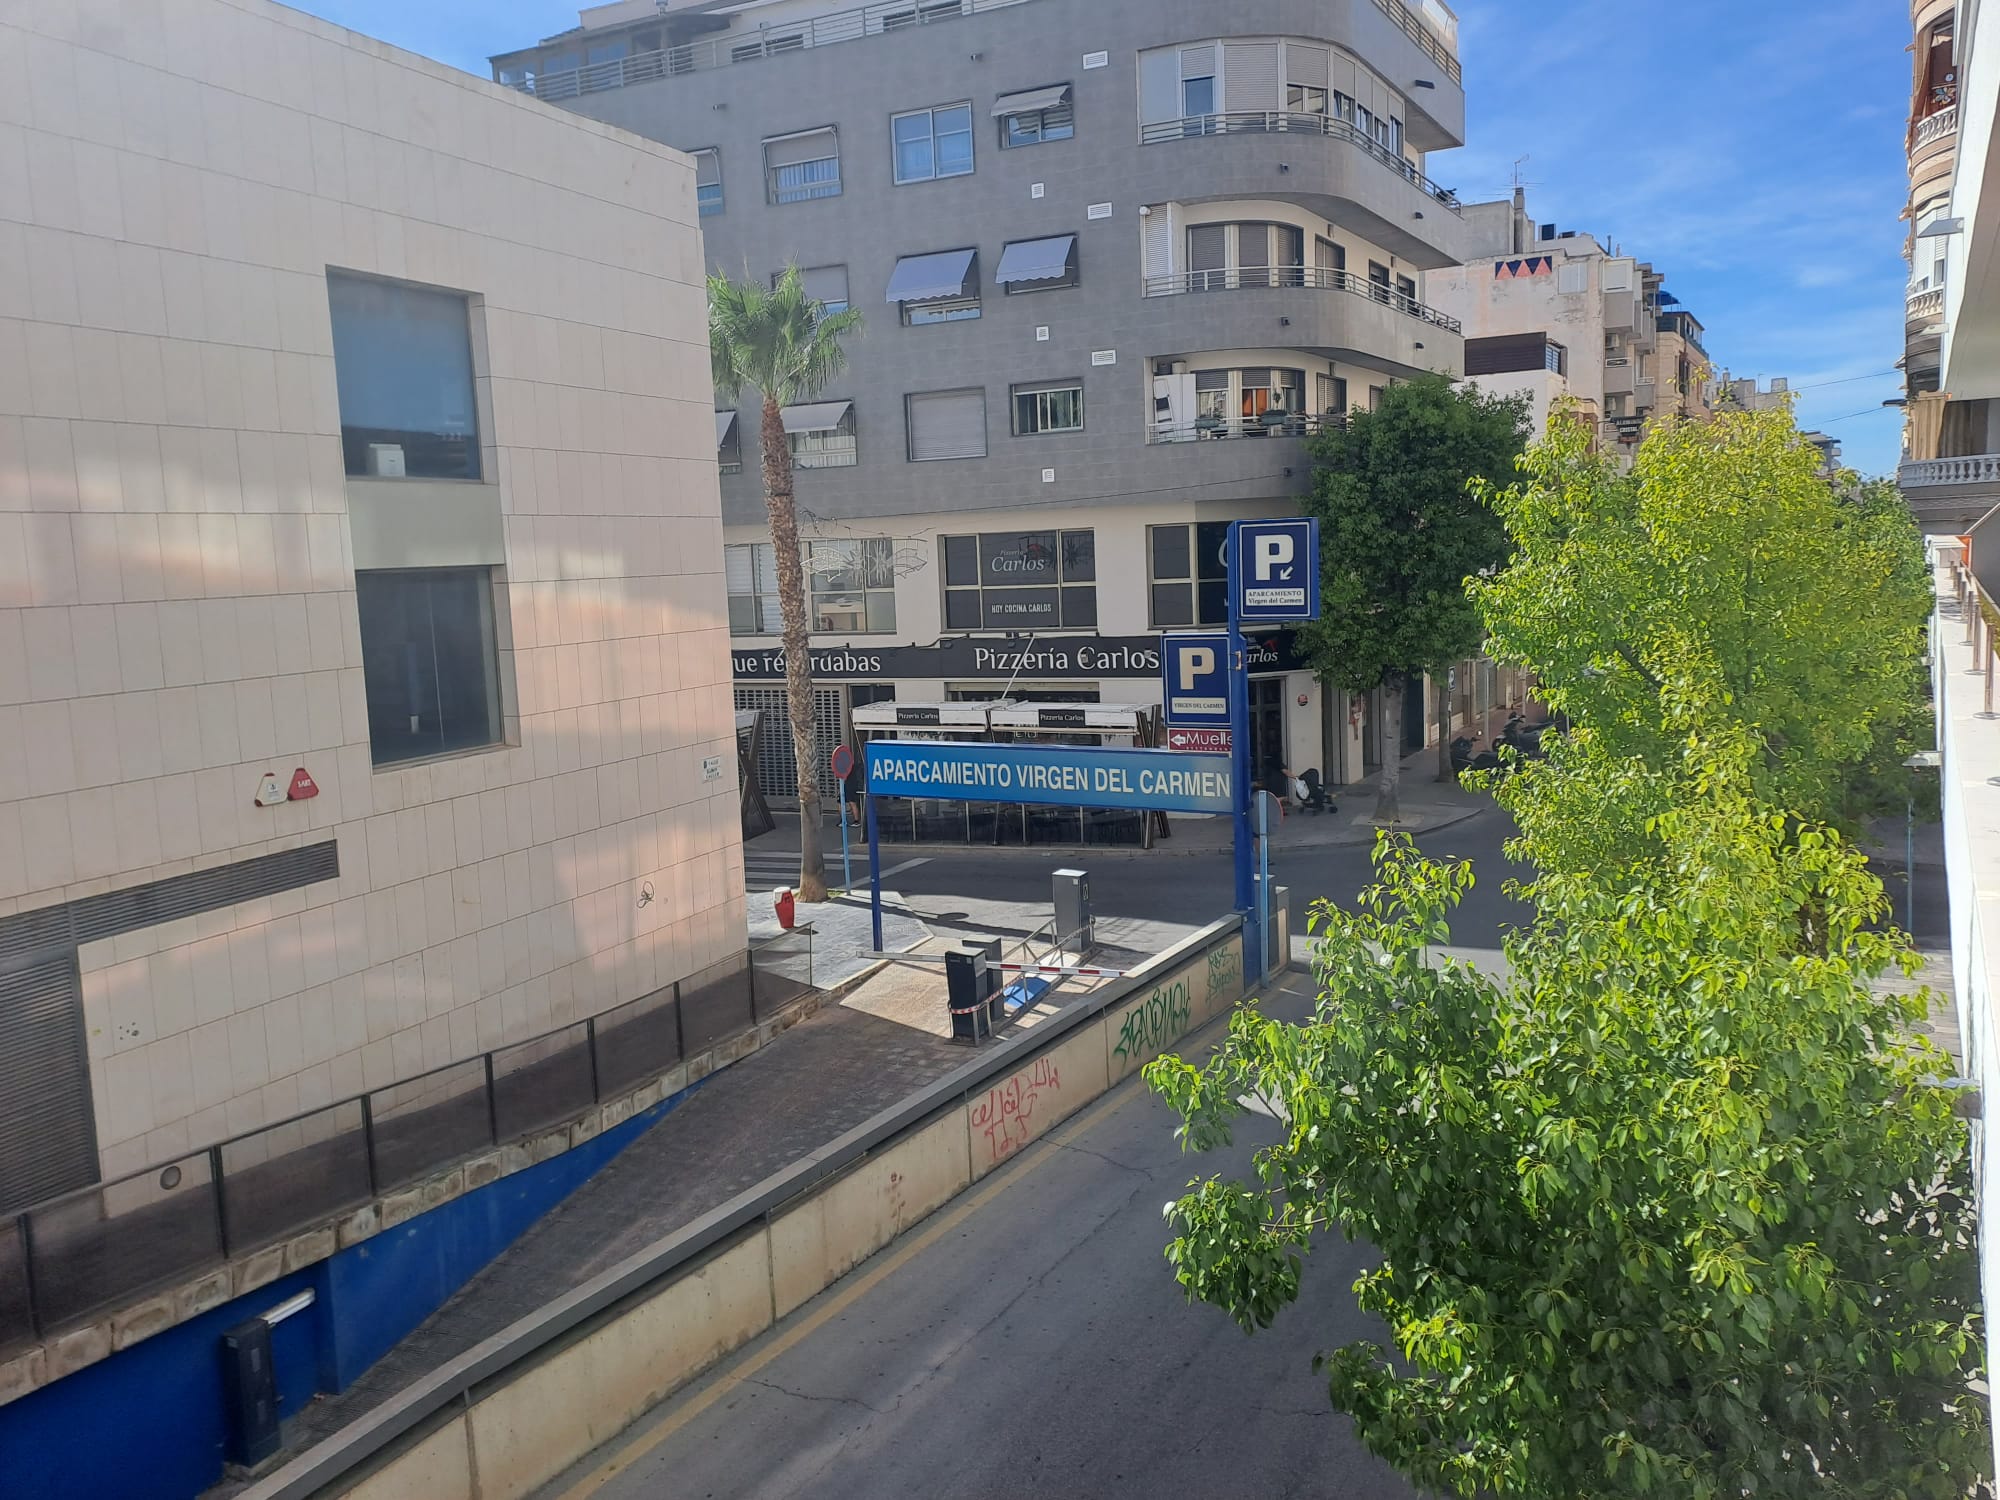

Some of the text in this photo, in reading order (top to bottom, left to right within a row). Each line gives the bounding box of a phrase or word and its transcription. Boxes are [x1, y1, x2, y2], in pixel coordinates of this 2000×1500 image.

[991, 555, 1045, 572] Carlos
[1255, 534, 1294, 581] P
[991, 603, 1052, 614] HOY COCINA CARLOS
[1268, 597, 1278, 605] del
[1279, 596, 1302, 604] Carmen
[974, 646, 1160, 670] Pizzería Carlos
[1179, 647, 1215, 690] P
[872, 758, 1231, 798] APARCAMIENTO VIRGEN DEL CARMEN
